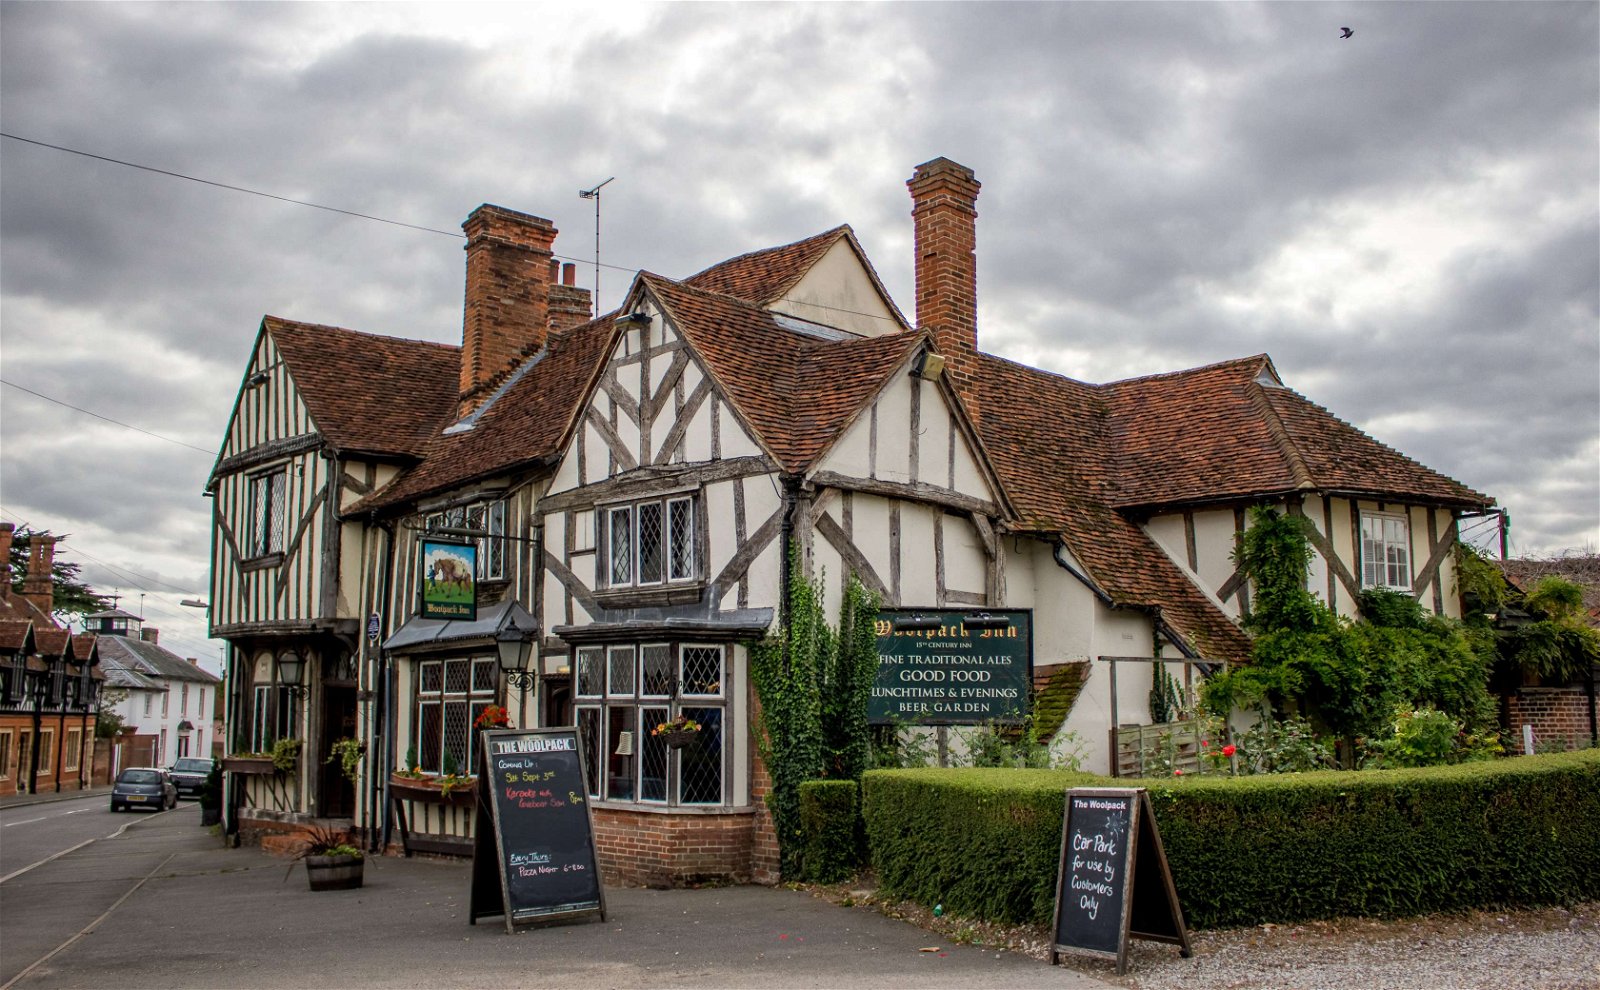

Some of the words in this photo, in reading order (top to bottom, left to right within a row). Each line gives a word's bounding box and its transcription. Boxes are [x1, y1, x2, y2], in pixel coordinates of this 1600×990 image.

[879, 655, 904, 664] FINE
[907, 655, 985, 665] TRADITIONAL
[987, 655, 1012, 665] ALES
[900, 670, 945, 682] GOOD
[950, 670, 991, 682] FOOD
[872, 687, 945, 698] LUNCHTIMES
[948, 688, 957, 698] &
[961, 688, 1018, 698] EVENINGS
[899, 703, 929, 712] BEER
[934, 703, 990, 712] GARDEN
[497, 741, 517, 753] THE
[517, 739, 570, 752] WOOLPACK
[1074, 801, 1088, 809] The
[1089, 800, 1127, 810] Woolpack
[1073, 834, 1092, 851] Car
[1094, 834, 1117, 856] Park
[1072, 855, 1085, 871] for
[1087, 861, 1102, 872] use
[1105, 860, 1115, 882] by
[1071, 874, 1113, 896] Customers
[1080, 895, 1099, 920] Only
